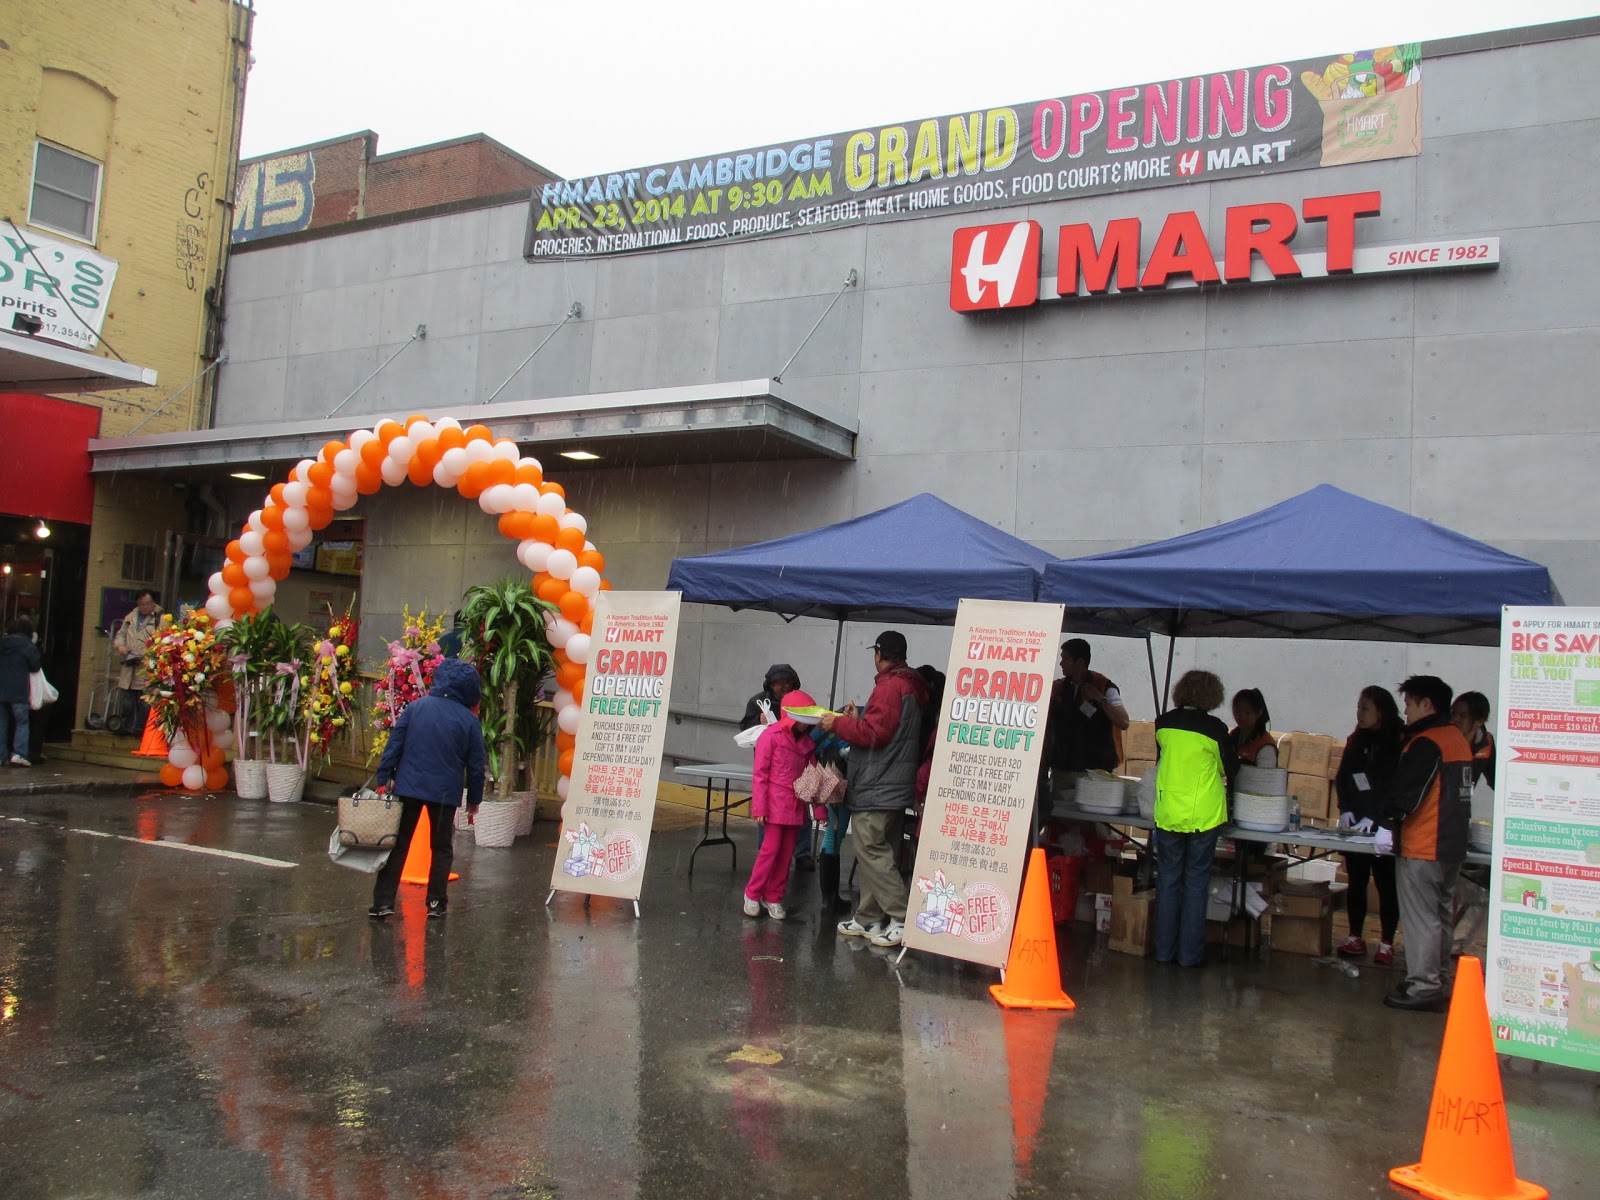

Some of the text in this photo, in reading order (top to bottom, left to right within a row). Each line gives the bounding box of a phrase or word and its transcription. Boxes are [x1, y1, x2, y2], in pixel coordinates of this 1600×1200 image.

[845, 64, 1292, 193] GRAND OPENING
[1347, 113, 1387, 132] HMART
[1207, 139, 1292, 171] MART
[541, 139, 834, 206] HMART CAMBRIDGE
[536, 171, 833, 232] APR. 23, 2014 AT 9:30 AM
[533, 237, 594, 256] GROCERIES,
[597, 226, 682, 252] INTERNATIONAL
[685, 221, 730, 243] FOODS,
[732, 212, 794, 236] PRODUCE,
[798, 201, 861, 227] SEAFOOD,
[864, 194, 906, 217] MEAT,
[909, 187, 950, 211] HOME
[953, 180, 1008, 205] GOODS,
[1012, 172, 1054, 197] FOOD
[1056, 191, 1382, 298] MART
[1387, 244, 1489, 266] SINCE 1982
[974, 626, 997, 635] Korean
[998, 628, 1027, 637] Tradition
[1027, 630, 1047, 638] Made
[1523, 620, 1591, 629] APPLY FOR HMART
[622, 629, 665, 643] MART
[977, 634, 1005, 643] America.
[1006, 636, 1024, 645] Since
[1024, 638, 1042, 646] 1982.
[1511, 632, 1549, 652] BIG
[596, 649, 668, 676] GRAND
[986, 645, 1041, 663] MART
[1511, 653, 1582, 667] FOR SMART
[1510, 666, 1572, 680] LIKE YOU!
[592, 675, 664, 698] OPENING
[955, 667, 1044, 703] GRAND
[590, 697, 662, 717] FREE GIFT
[950, 697, 1039, 729] OPENING
[593, 721, 652, 733] PURCHASE OVER $20
[1510, 711, 1535, 719] Collect
[1542, 713, 1562, 723] point
[1563, 713, 1575, 721] for
[1575, 716, 1597, 725] every
[1510, 720, 1599, 732] 1,000 points $10 Gift
[591, 731, 651, 744] AND GET FREE GIFT
[947, 722, 1035, 751] FREE GIFT
[594, 742, 644, 755] (GIFTS MAY VARY
[1522, 751, 1537, 760] HOW
[582, 751, 655, 767] DEPENDING ON EACH DAY)
[950, 751, 1022, 770] PURCHASE OVER $20
[587, 764, 644, 778] H마트 오픈 기념
[948, 763, 1021, 782] AND GET A FREE GIFT
[584, 783, 641, 798] 무료 사은품 증정
[587, 774, 640, 788] $20이상 구매시
[952, 776, 1012, 794] (GIFTS MAY VARY
[937, 786, 1025, 810] DEPENDING ON EACH DAY)
[944, 802, 1011, 822] H마트 오픈 기념
[944, 814, 1007, 834] $20이상 구매시
[1506, 819, 1599, 838] Exclusive sales prices
[939, 825, 1008, 847] 무료 사은품 증정
[1505, 831, 1584, 849] for members only.
[607, 839, 632, 858] FREE
[609, 854, 632, 873] GIFT
[1503, 858, 1578, 875] Special Events for
[967, 895, 998, 915] FREE
[969, 913, 998, 934] GIFT
[1502, 912, 1538, 926] Coupons
[1540, 916, 1558, 928] Sent
[1560, 919, 1572, 932] by
[1572, 921, 1593, 933] Mail
[1502, 923, 1533, 936] E-mail
[1535, 928, 1549, 939] for
[1551, 931, 1592, 944] members
[1512, 1029, 1558, 1047] MART
[1433, 1089, 1502, 1136] HMART
